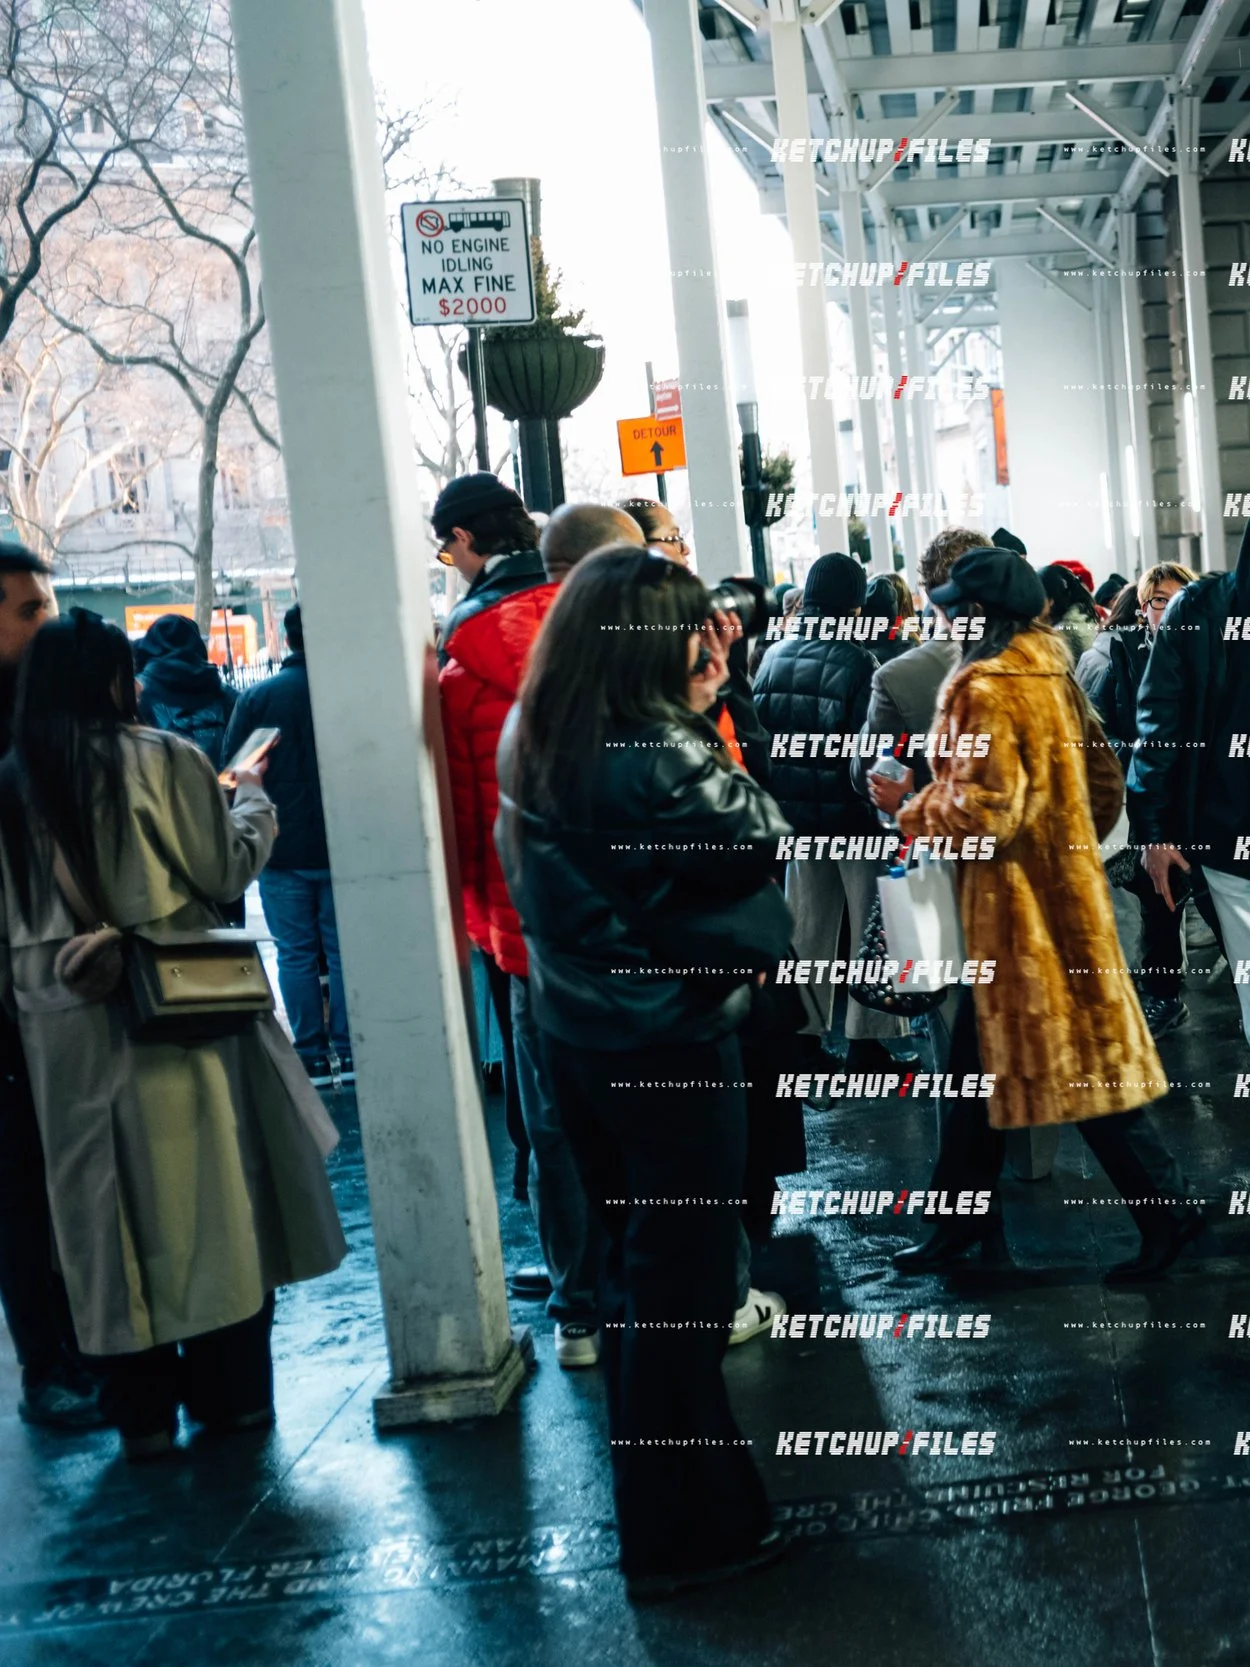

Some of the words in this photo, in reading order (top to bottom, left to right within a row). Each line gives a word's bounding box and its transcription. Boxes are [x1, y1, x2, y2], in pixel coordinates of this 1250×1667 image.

[422, 239, 444, 255] NO
[452, 237, 511, 254] ENGINE
[441, 256, 493, 272] IDLING
[422, 276, 465, 294] MAX
[474, 274, 516, 292] FINE
[438, 296, 507, 317] $2000
[632, 424, 677, 440] DETOUR
[1102, 1463, 1167, 1485] FOR
[1066, 1478, 1200, 1508] GEORGE
[773, 1501, 838, 1521] CRE
[201, 1582, 270, 1605] THE
